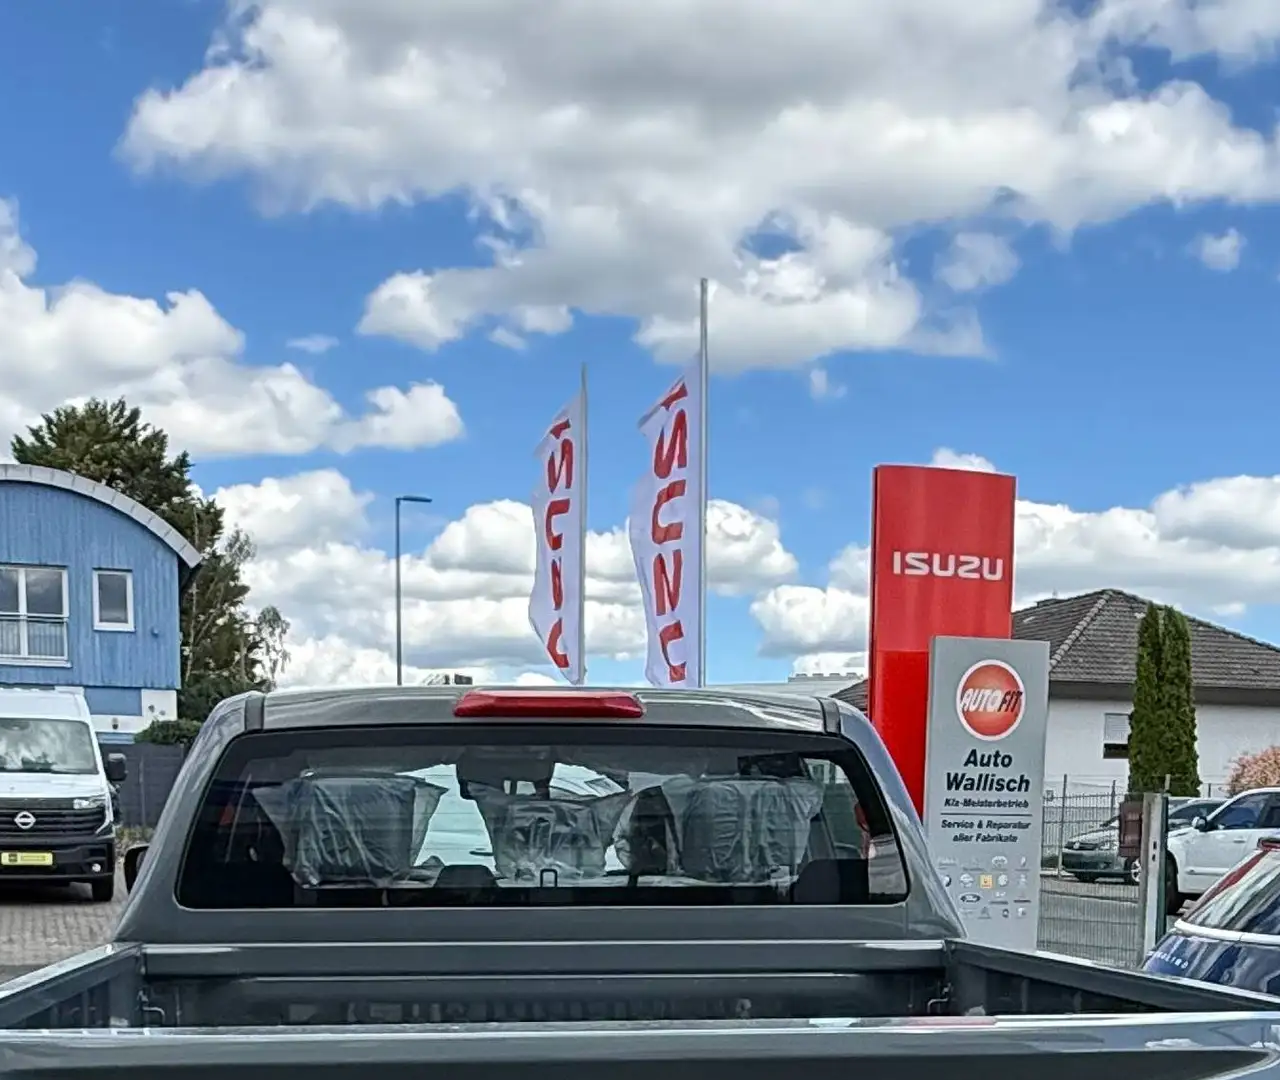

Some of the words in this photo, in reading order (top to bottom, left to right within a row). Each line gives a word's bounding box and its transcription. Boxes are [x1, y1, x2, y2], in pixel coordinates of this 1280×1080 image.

[892, 551, 1004, 581] ISUZU
[963, 748, 1013, 769] Auto
[946, 771, 1031, 792] Wallisch
[943, 797, 1030, 809] Kfz-Meisterbetrieb
[941, 819, 975, 829] Service
[986, 819, 1032, 831] Reparatur
[952, 832, 975, 842] aller
[975, 832, 1019, 843] Fabrikate
